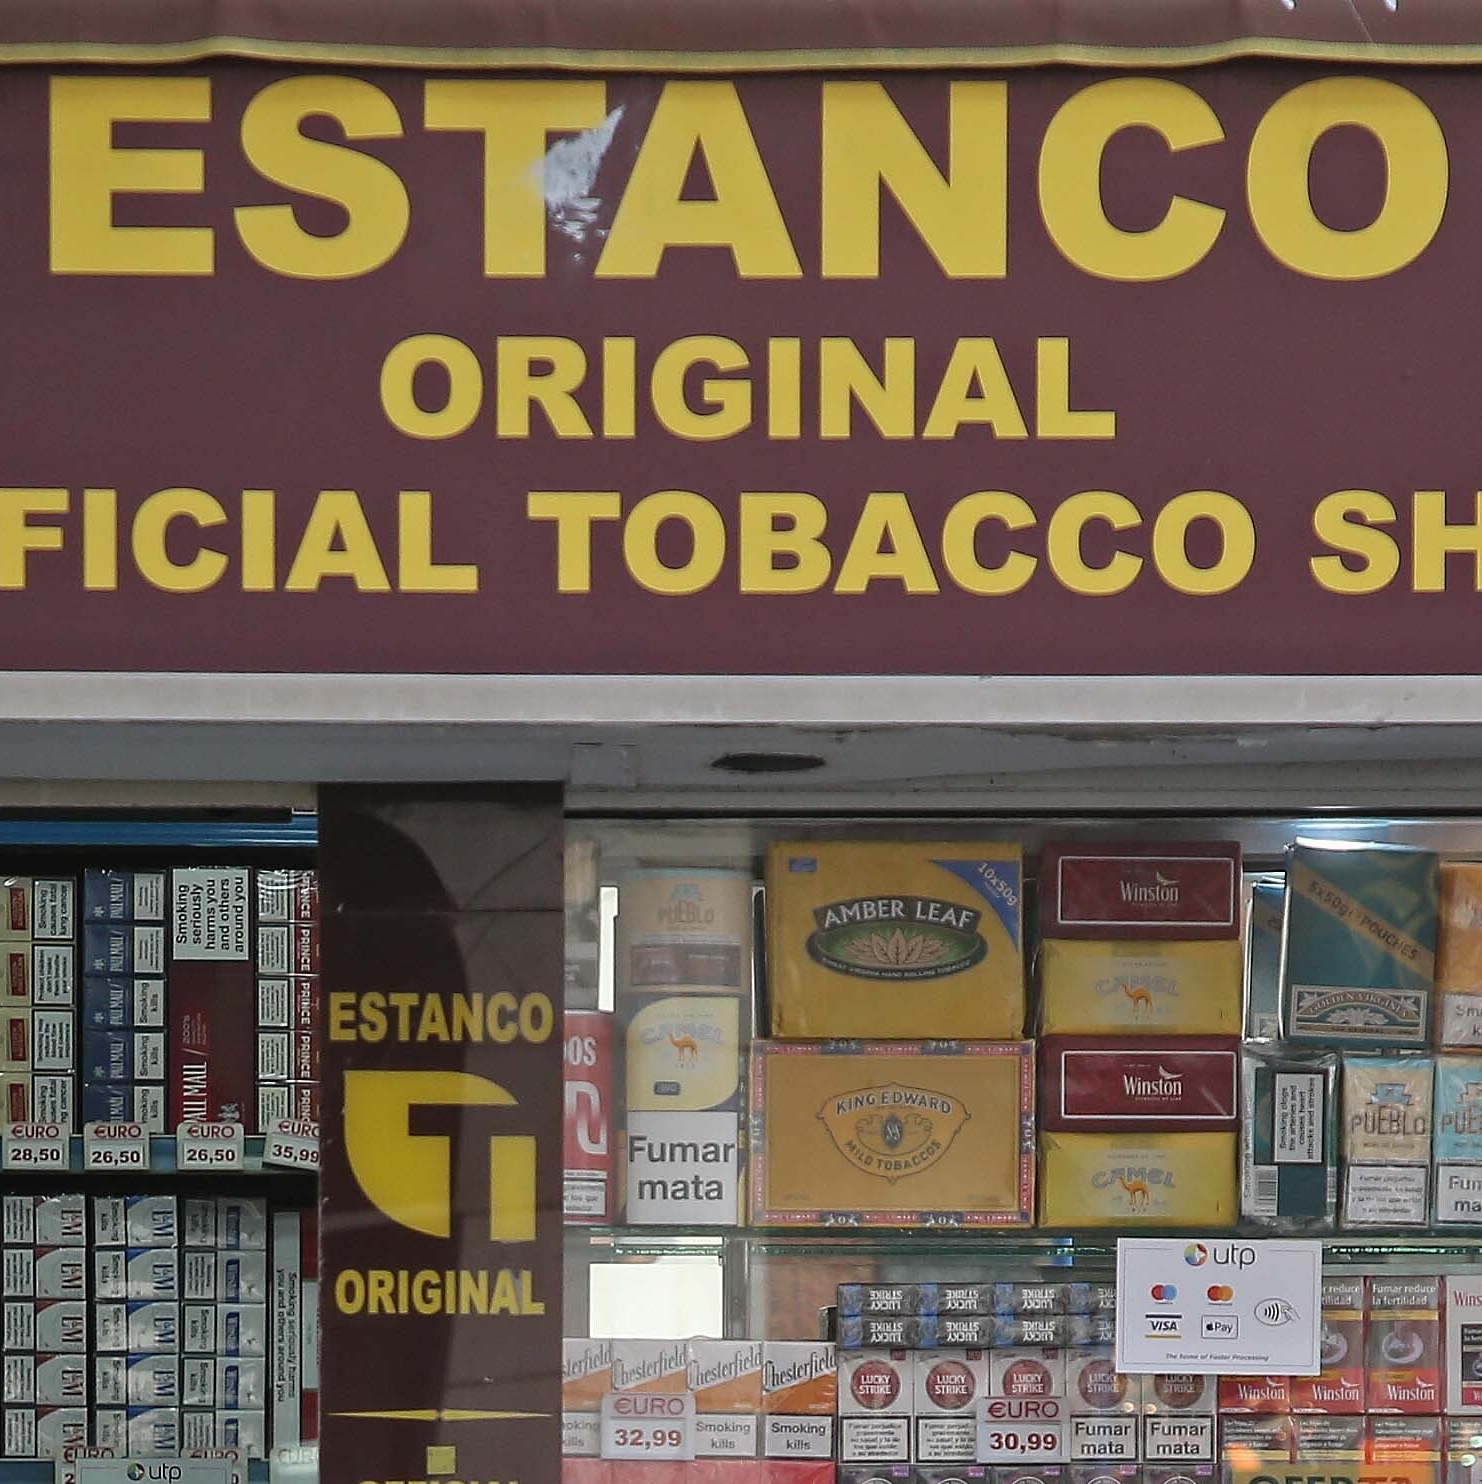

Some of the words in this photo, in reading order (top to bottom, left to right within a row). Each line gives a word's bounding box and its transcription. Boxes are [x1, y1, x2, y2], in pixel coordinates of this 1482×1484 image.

[47, 75, 1449, 282] ESTANCO
[379, 333, 1117, 442] ORIGINAL
[528, 489, 1258, 596] TOBACCO
[823, 899, 905, 930] AMBER
[915, 900, 975, 931] LEAF
[328, 991, 555, 1044] ESTANCO
[835, 1090, 877, 1116] KING
[881, 1090, 952, 1116] EDWARD
[91, 1148, 141, 1165] 26,50
[186, 1147, 236, 1164] 26,50
[628, 1135, 735, 1164] Fumar
[638, 1174, 725, 1202] mata
[1213, 1243, 1256, 1271] utp
[334, 1269, 546, 1316] ORIGINAL
[614, 1428, 683, 1449] 32,99
[771, 1421, 826, 1436] Smoking
[989, 1431, 1058, 1453] 30,99
